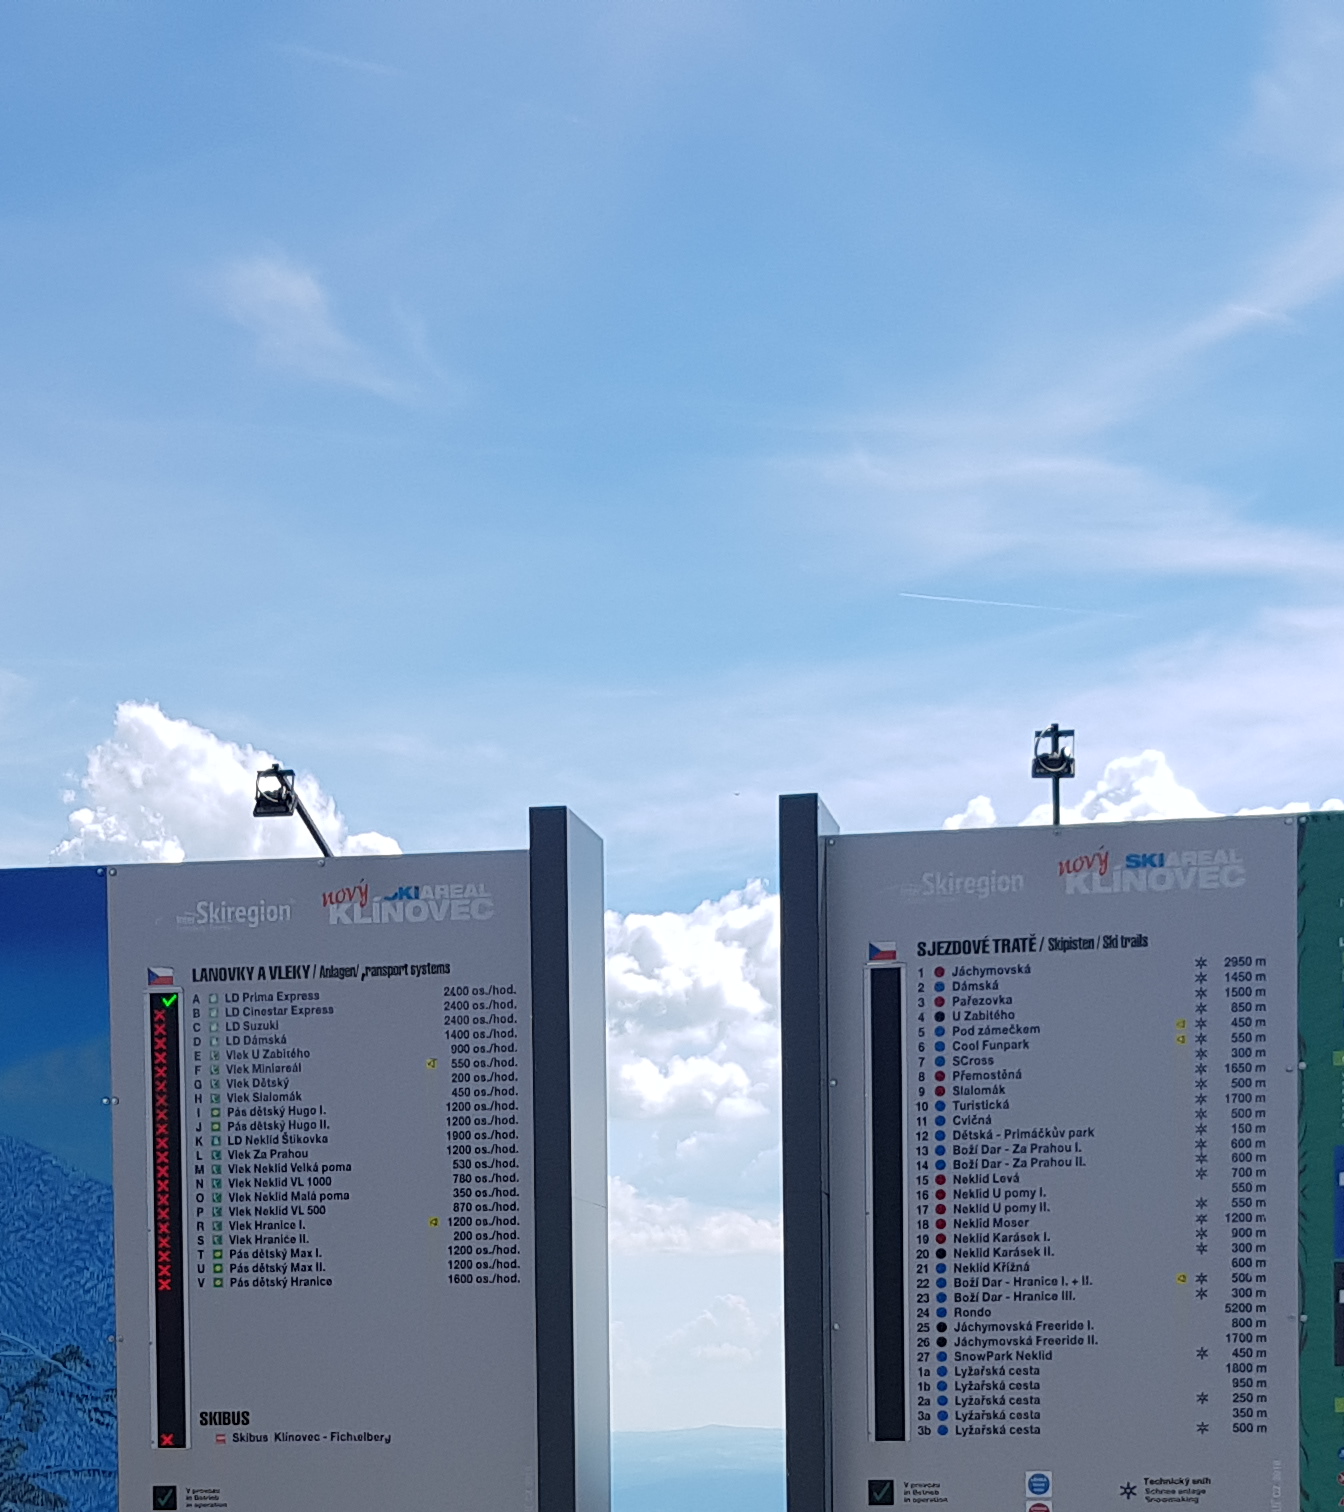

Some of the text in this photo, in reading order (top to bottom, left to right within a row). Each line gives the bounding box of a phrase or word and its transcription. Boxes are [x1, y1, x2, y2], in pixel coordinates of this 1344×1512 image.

[1059, 846, 1109, 877] nový
[323, 879, 368, 907] nový
[196, 900, 292, 929] Skiregion
[329, 897, 493, 924] KLÍNOVEC
[917, 934, 990, 956] SJEZDOVÉ
[193, 963, 450, 982] LANOVKY A VLEKY systems
[952, 956, 1266, 979] Jáchymovská 2950 m
[953, 972, 1266, 991] Dámská 1450 m
[226, 1007, 240, 1017] LD
[444, 1001, 469, 1011] 2400
[953, 1011, 961, 1021] U
[1231, 1002, 1252, 1012] 850
[953, 1026, 975, 1036] Pod
[1231, 1017, 1252, 1027] 450
[226, 1036, 240, 1045] LD
[244, 1034, 286, 1045] Dámská
[445, 1030, 469, 1039] 1400
[953, 1033, 1252, 1051] Cool Funpark 550
[953, 1048, 1252, 1066] SCross 300
[228, 1107, 247, 1117] Pás
[289, 1106, 316, 1117] Hugo
[446, 1102, 471, 1111] 1200
[916, 1102, 928, 1111] 10
[1226, 1093, 1253, 1103] 1700
[916, 1131, 928, 1141] 12
[1069, 1128, 1094, 1140] park
[1232, 1123, 1253, 1133] 150
[228, 1150, 251, 1159] Vlek
[253, 1149, 268, 1159] Za
[270, 1149, 308, 1158] Prahou
[447, 1145, 471, 1154] 1200
[308, 1176, 331, 1186] 1000
[453, 1174, 471, 1183] 780
[449, 1274, 473, 1283] 1600
[917, 1303, 1253, 1318] 24 Rondo 5200
[917, 1352, 930, 1362] 27
[955, 1351, 1013, 1361] SnowPark
[1232, 1348, 1253, 1357] 450
[200, 1411, 249, 1425] SKIBUS
[233, 1433, 268, 1442] Skibus
[918, 1426, 931, 1435] 3b
[1010, 1426, 1040, 1434] cesta
[1233, 1423, 1253, 1432] 500
